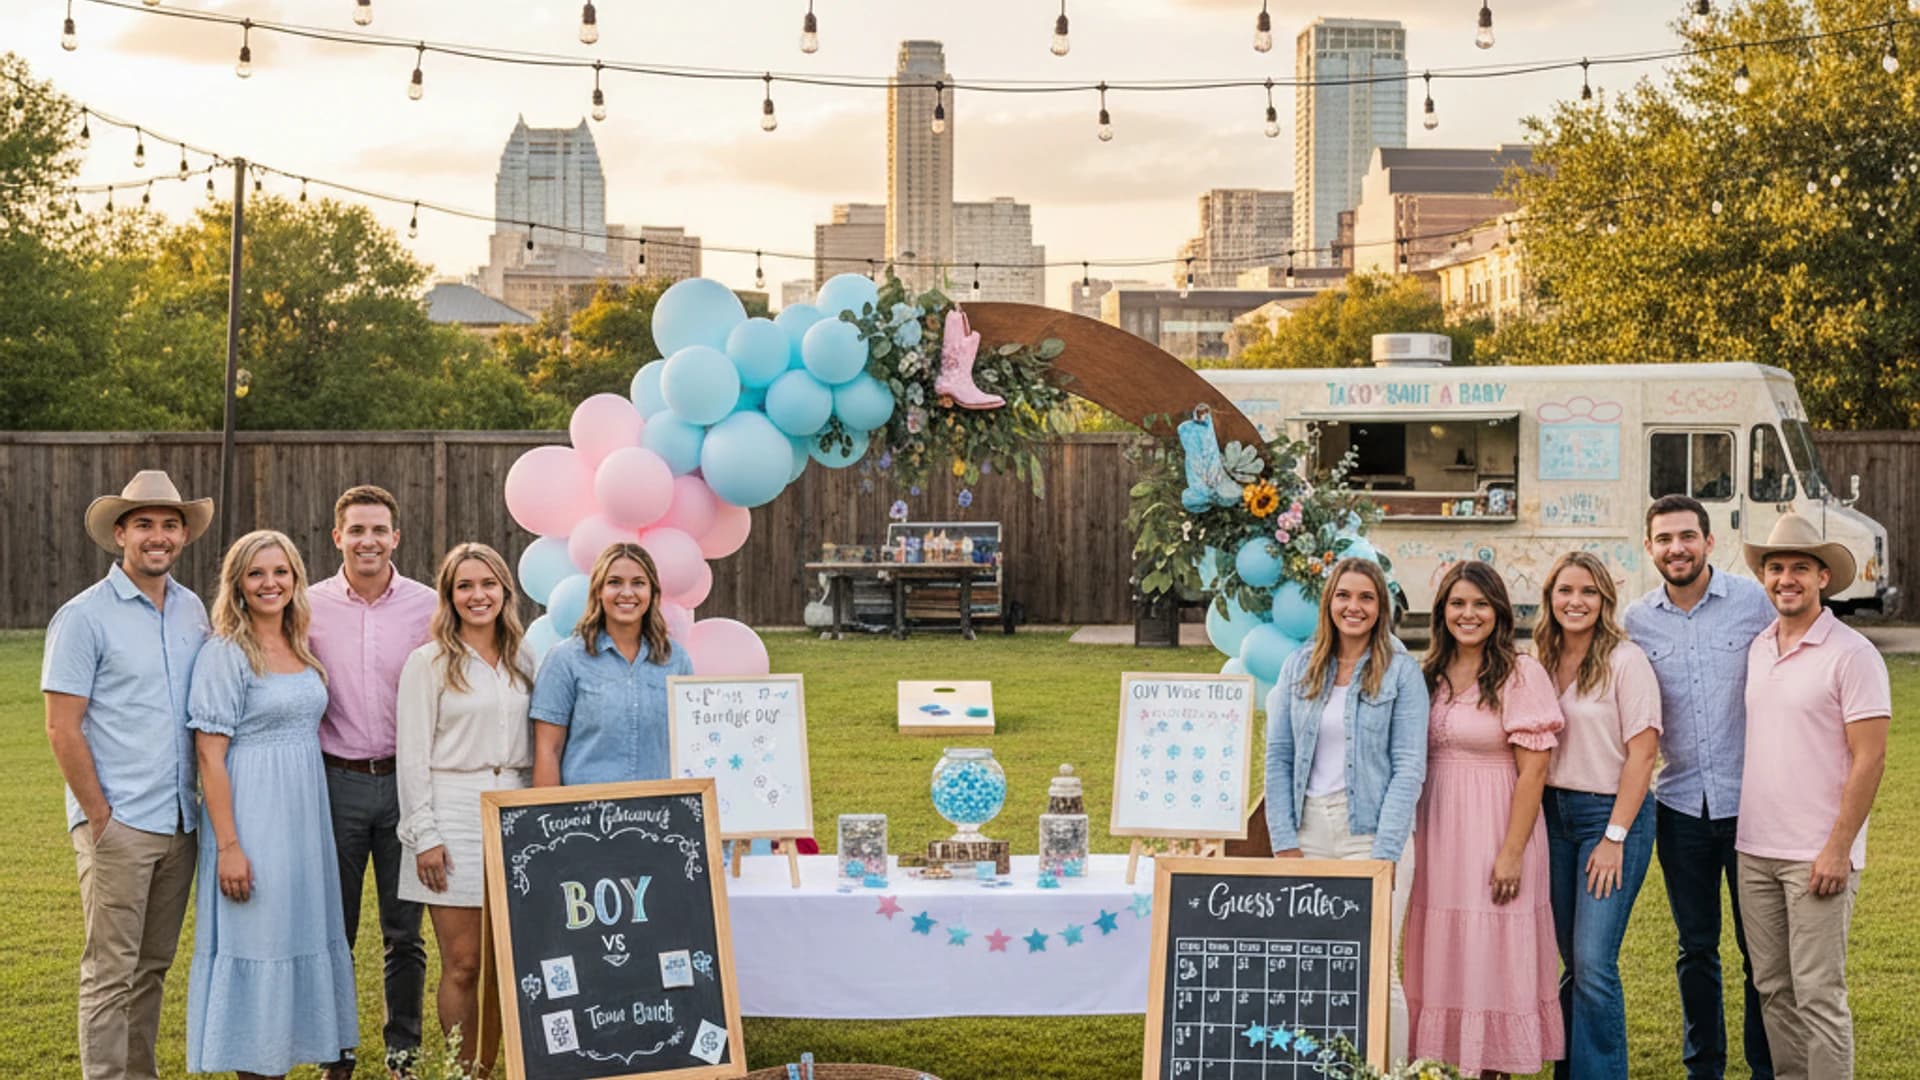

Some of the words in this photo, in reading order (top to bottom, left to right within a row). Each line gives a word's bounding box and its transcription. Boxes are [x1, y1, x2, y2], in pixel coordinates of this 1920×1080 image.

[1440, 384, 1453, 404] A
[560, 876, 652, 929] BOY
[602, 933, 626, 951] VS
